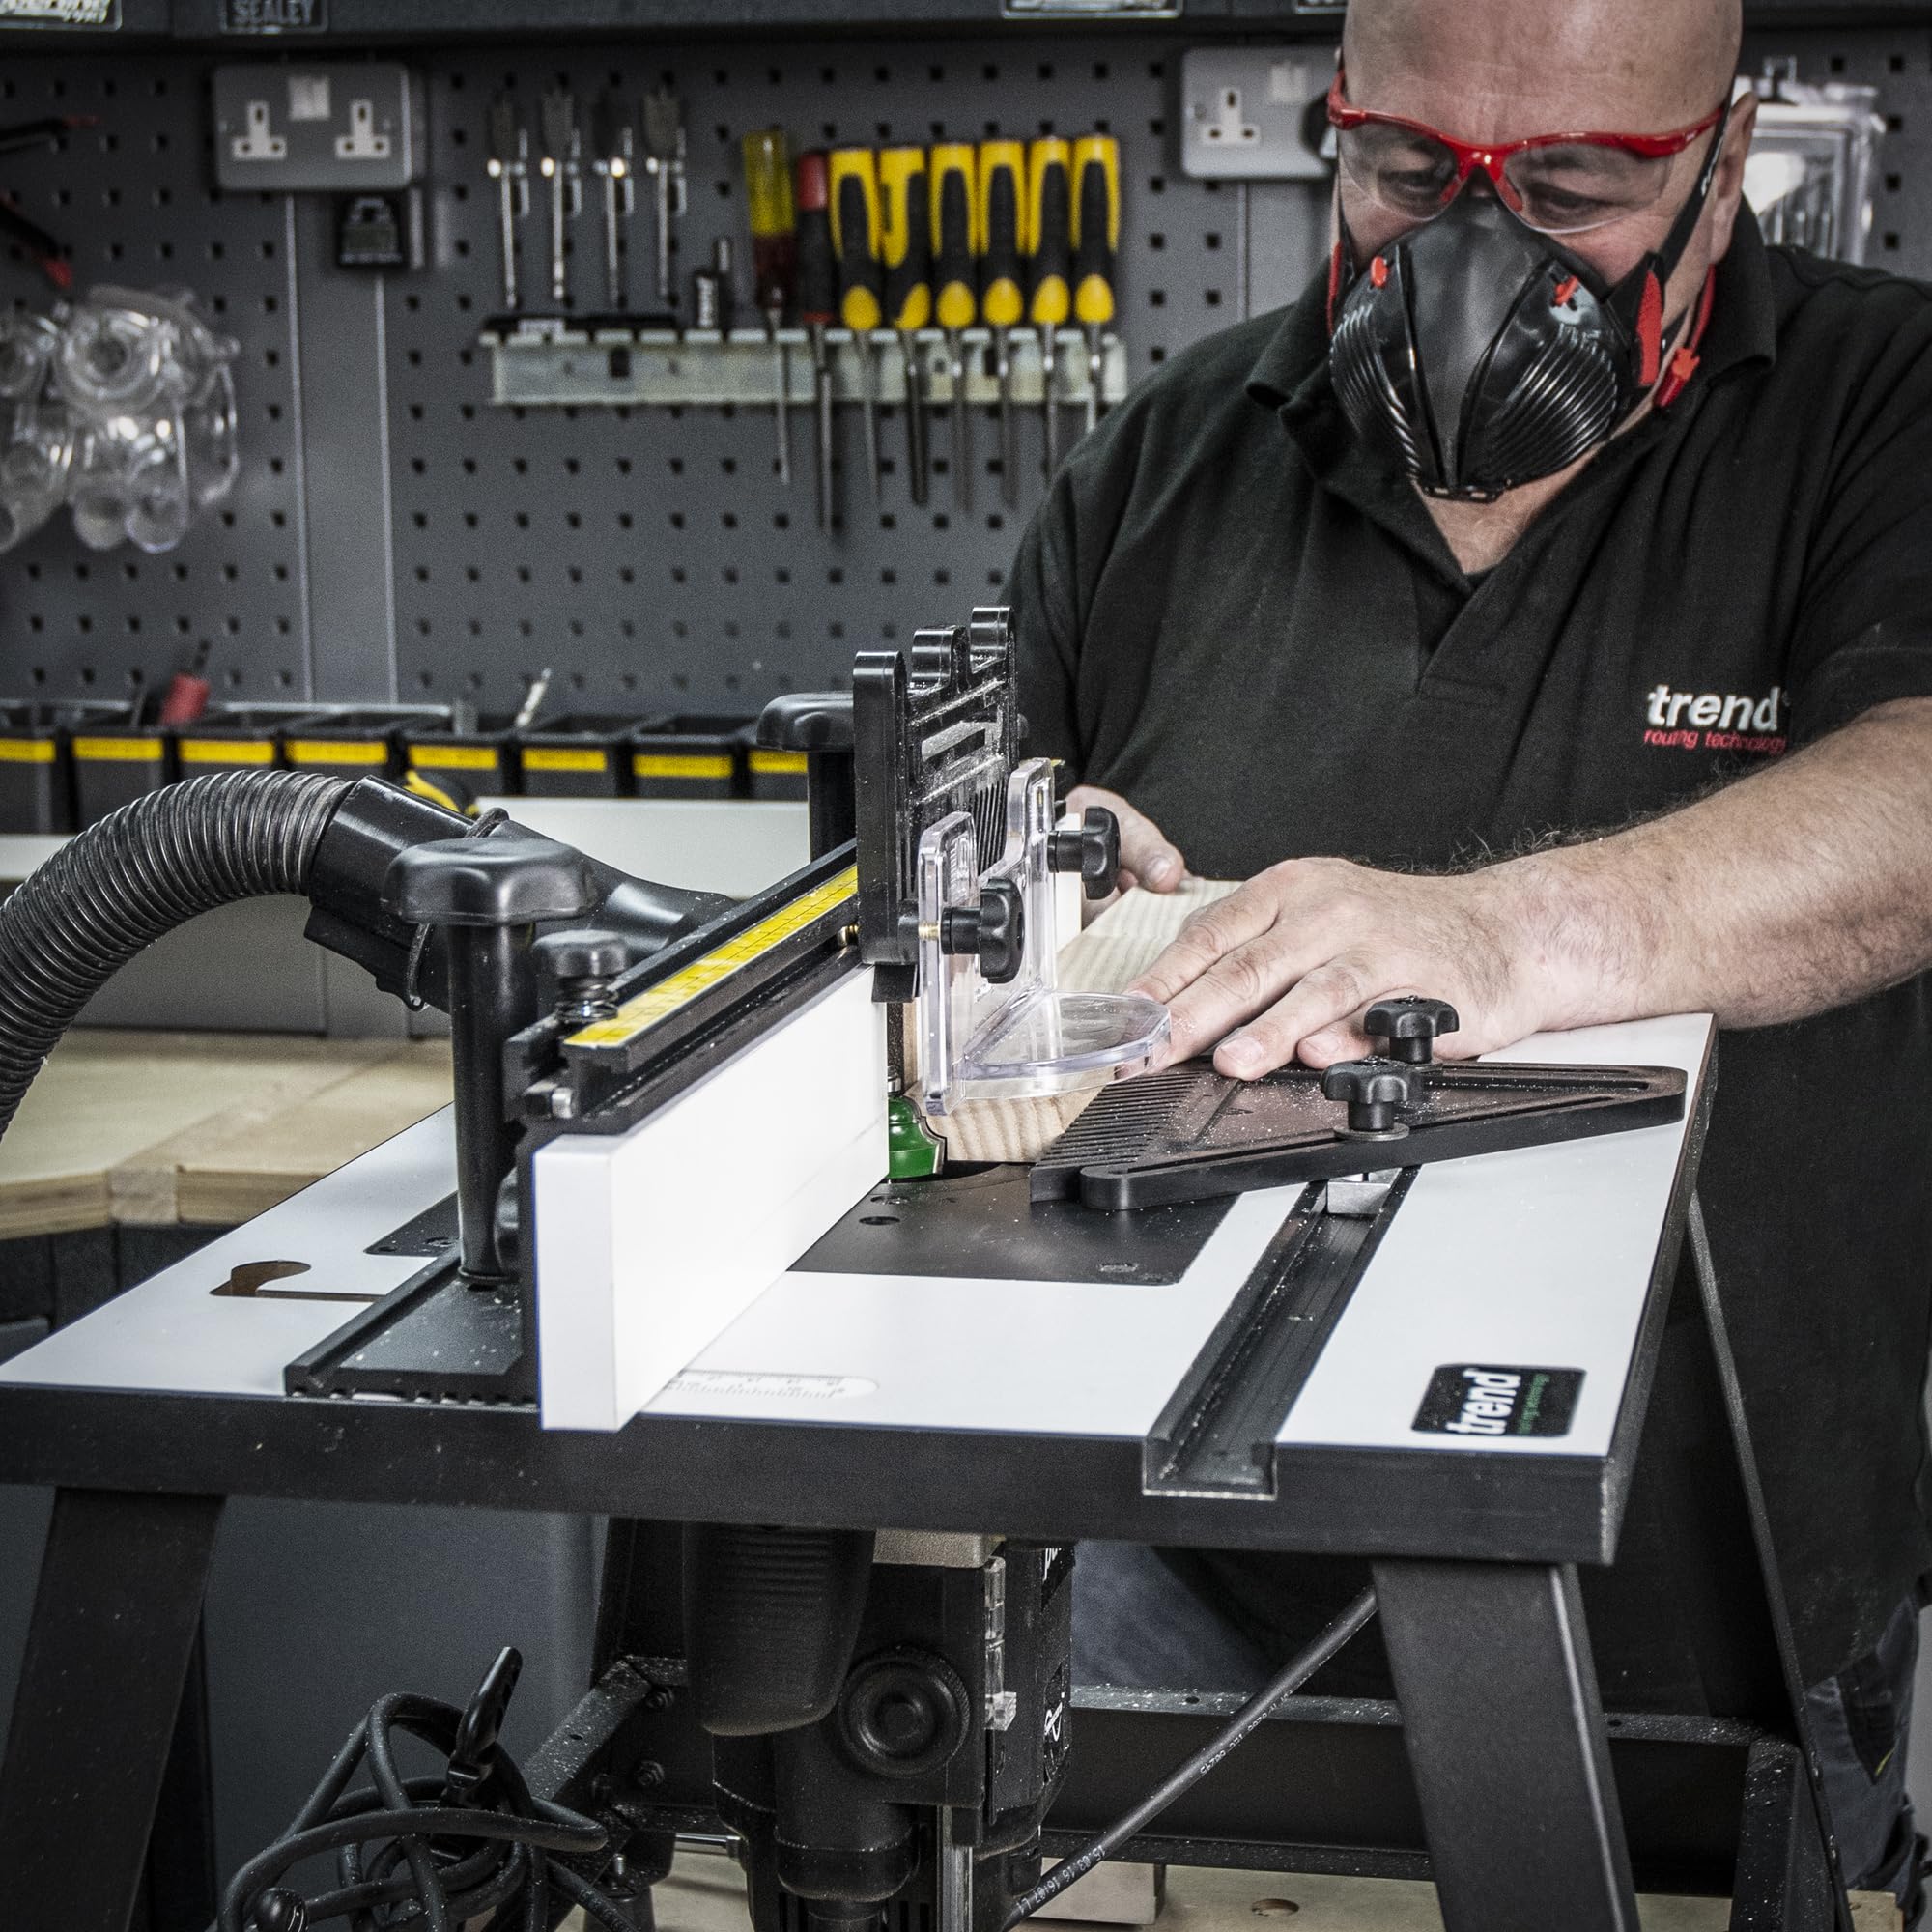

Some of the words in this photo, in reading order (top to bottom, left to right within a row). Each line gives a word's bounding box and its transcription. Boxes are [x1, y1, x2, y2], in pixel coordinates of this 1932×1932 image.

[1646, 684, 1781, 731] trend
[1705, 730, 1787, 753] technology
[1445, 1367, 1522, 1435] trend
